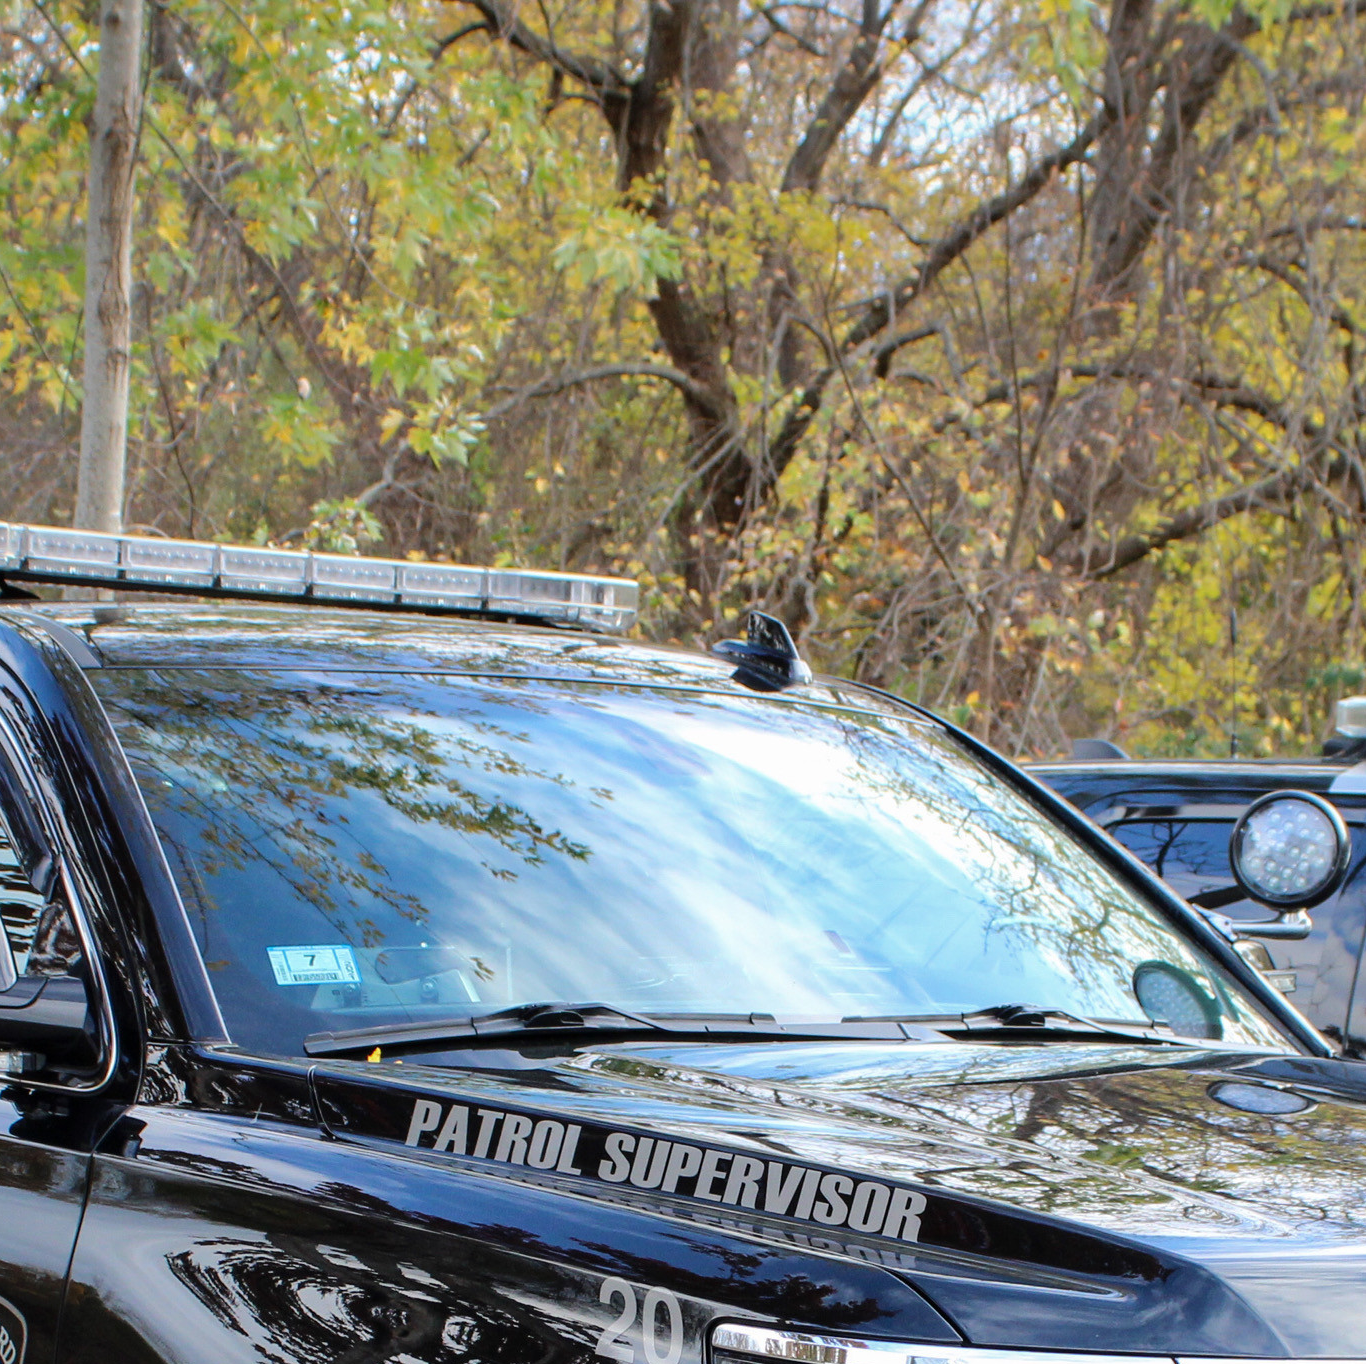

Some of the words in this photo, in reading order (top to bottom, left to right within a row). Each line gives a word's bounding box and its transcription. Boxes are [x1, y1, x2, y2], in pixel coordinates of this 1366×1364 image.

[303, 954, 317, 967] 7
[405, 1098, 582, 1176] PATROL
[598, 1131, 928, 1243] SUPERVISOR
